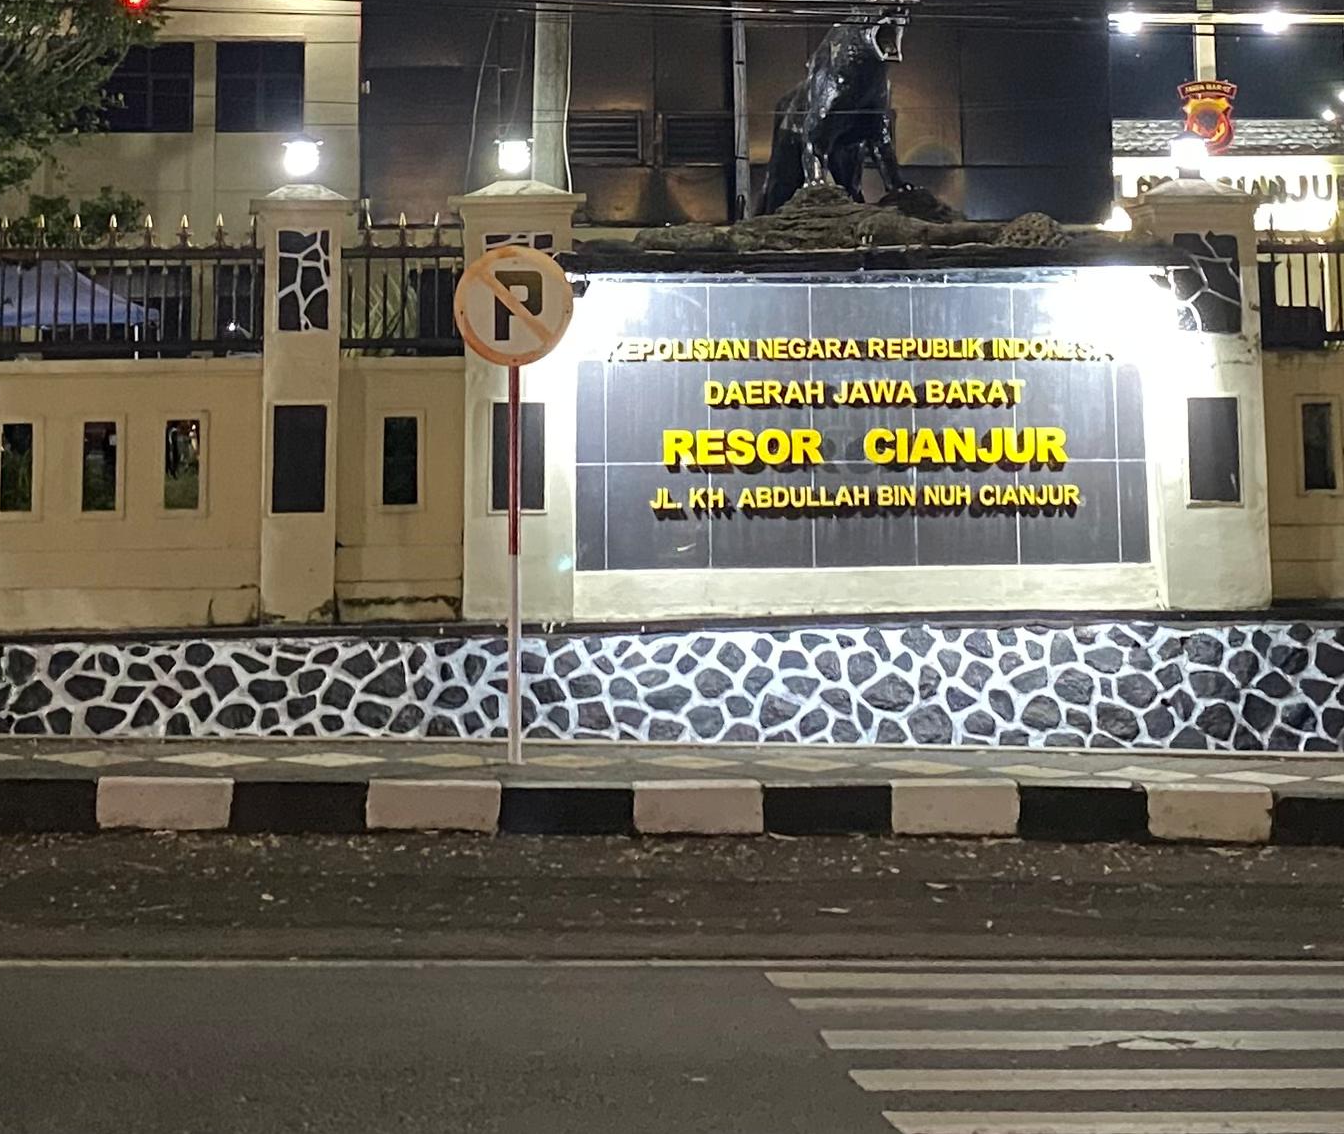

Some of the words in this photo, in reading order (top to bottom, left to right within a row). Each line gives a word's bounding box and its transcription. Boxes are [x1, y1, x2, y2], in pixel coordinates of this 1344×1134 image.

[757, 337, 861, 359] NEGARA
[867, 337, 984, 359] REPUBLIK
[704, 380, 825, 405] DAERAH
[832, 380, 917, 404] JAWA
[925, 379, 1026, 404] BARAT
[662, 428, 825, 465] RESOR
[863, 427, 1069, 464] CIANJUR
[649, 487, 683, 509] JL.
[688, 486, 725, 509] KH
[736, 485, 870, 508] ABDULLAH
[876, 484, 917, 507] BIN
[923, 484, 972, 507] NUH
[978, 484, 1081, 507] CIANJUR
